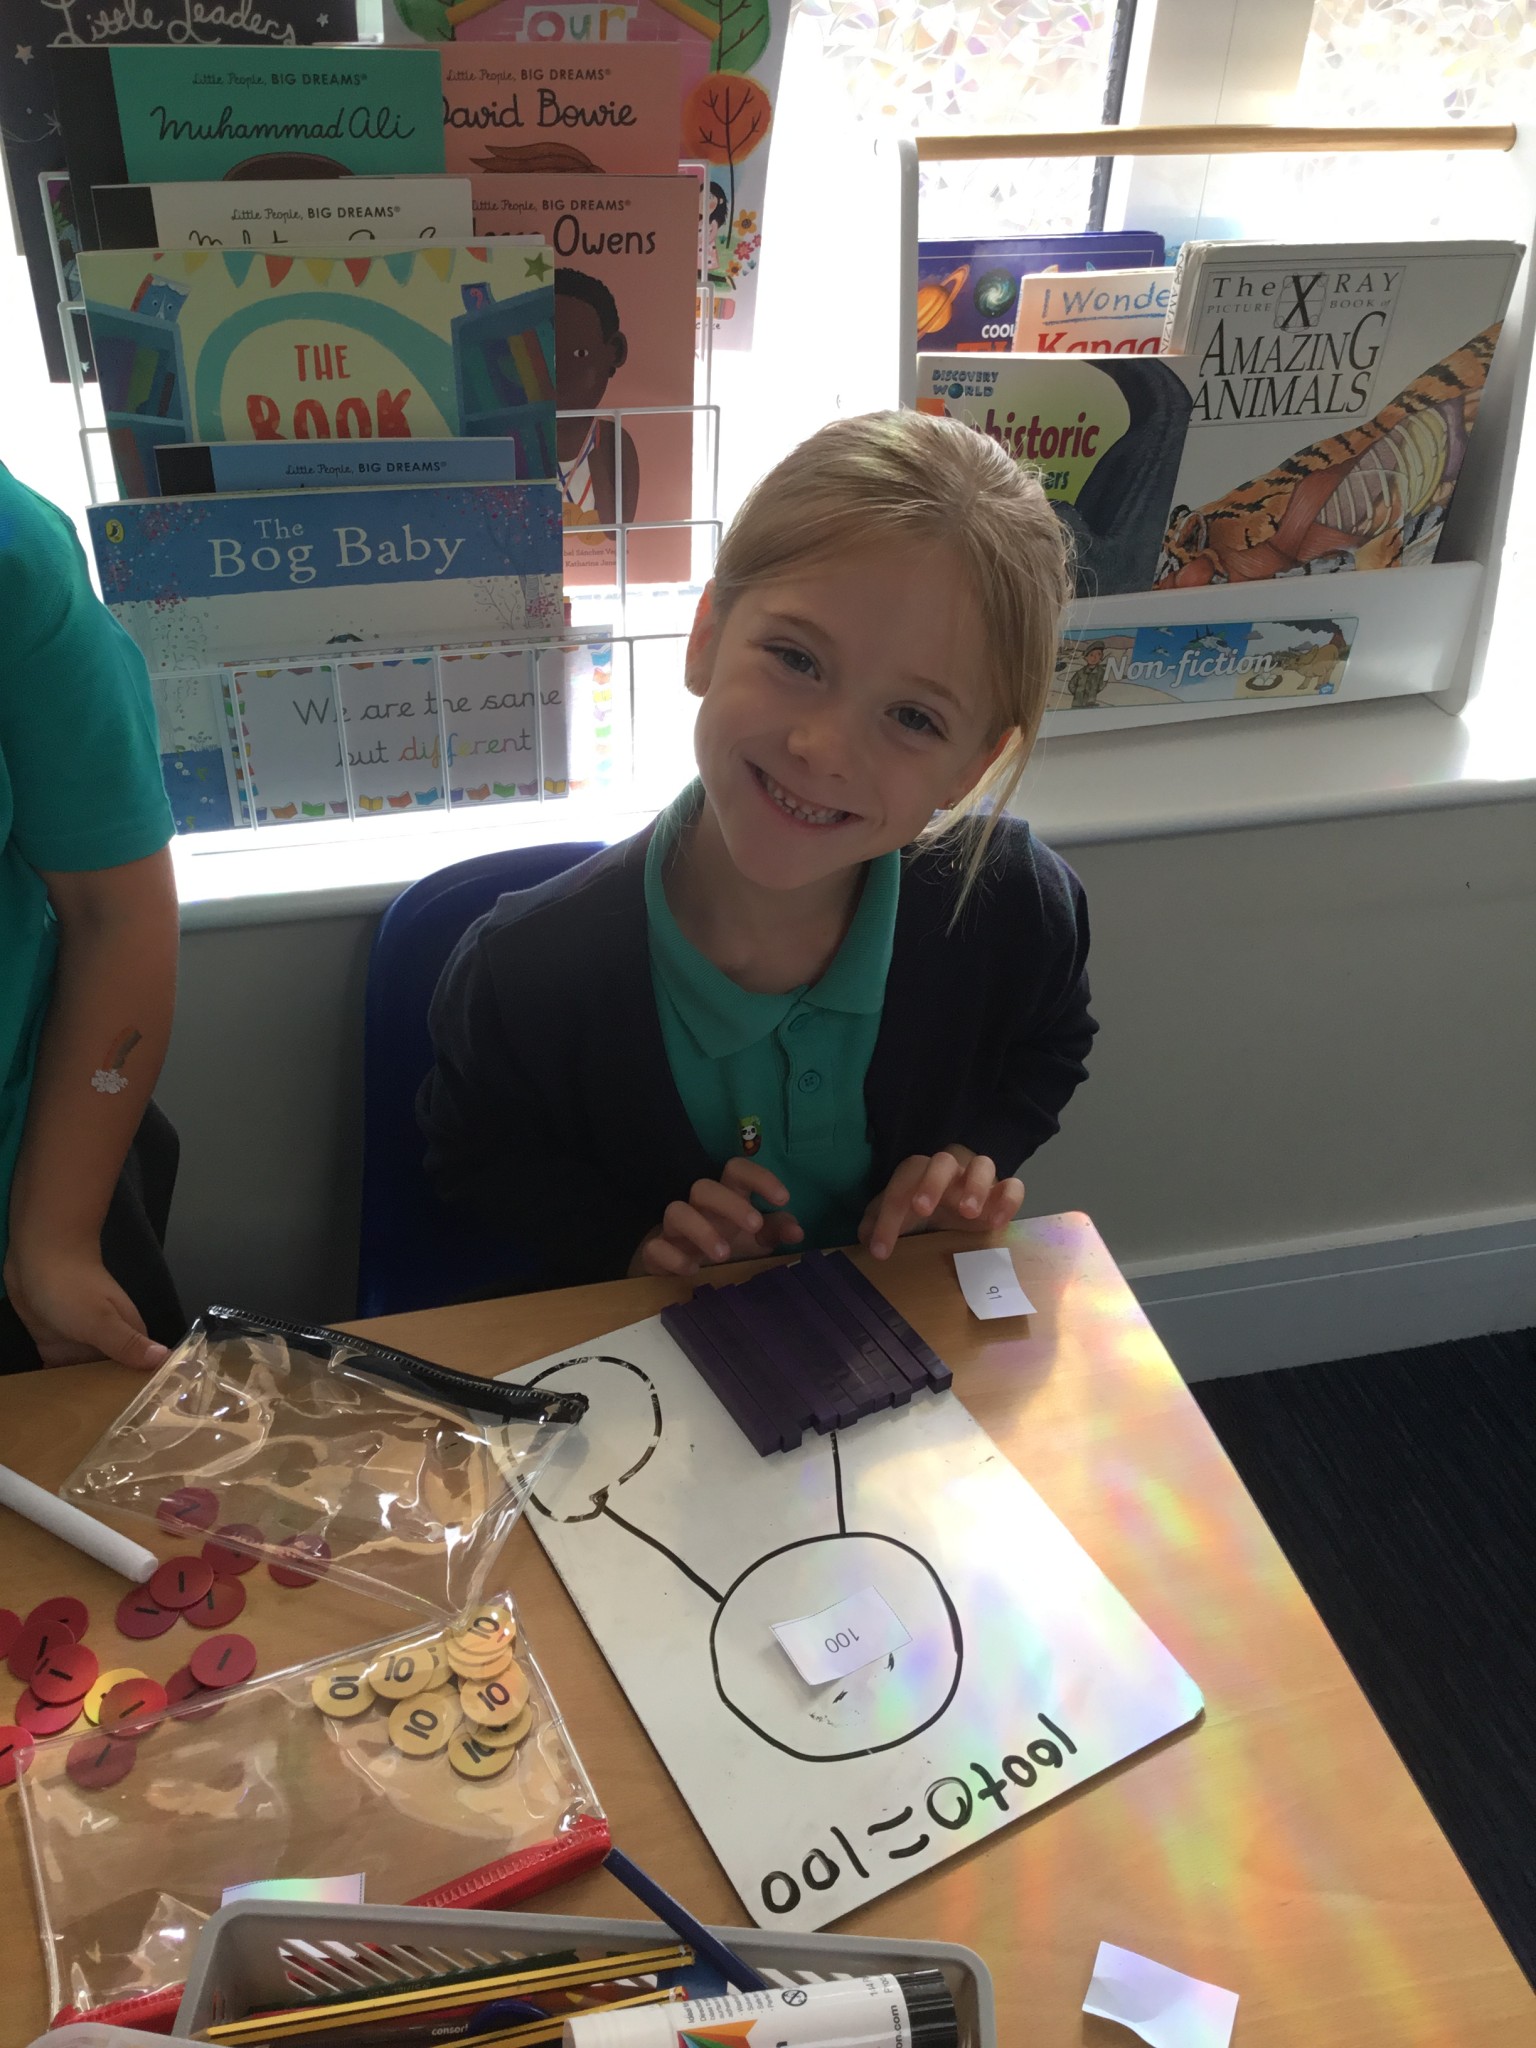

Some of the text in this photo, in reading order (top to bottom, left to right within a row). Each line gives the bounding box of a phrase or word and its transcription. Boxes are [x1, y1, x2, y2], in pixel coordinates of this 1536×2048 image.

[41, 0, 296, 45] Little Leaders
[527, 6, 626, 40] our
[192, 73, 224, 86] Little
[271, 73, 296, 85] BIG
[446, 70, 476, 81] Little
[521, 69, 544, 80] BIG
[537, 88, 637, 127] Bowie
[150, 106, 415, 140] Muhammad Ali
[231, 209, 261, 220] Little
[308, 207, 331, 219] BIG
[542, 200, 564, 210] BIG
[553, 214, 656, 256] Owens
[1042, 289, 1050, 318] I
[1207, 303, 1272, 314] PICTURE
[1329, 299, 1373, 309] BOOK
[1213, 272, 1400, 331] The X RAY
[1199, 311, 1386, 377] AMAZING
[295, 344, 351, 381] THE
[932, 370, 999, 382] DISCOVERY
[1190, 371, 1371, 421] ANIMALS
[285, 464, 315, 475] Little
[359, 462, 382, 473] BIG
[253, 518, 304, 539] The
[208, 524, 466, 583] Bog Baby
[1102, 648, 1277, 688] Non-fiction
[360, 702, 414, 721] are
[398, 728, 533, 768] different
[824, 1627, 860, 1654] 100
[384, 1656, 415, 1682] 10
[329, 1676, 359, 1700] 10
[476, 1682, 510, 1712] 10
[403, 1709, 438, 1740] 10
